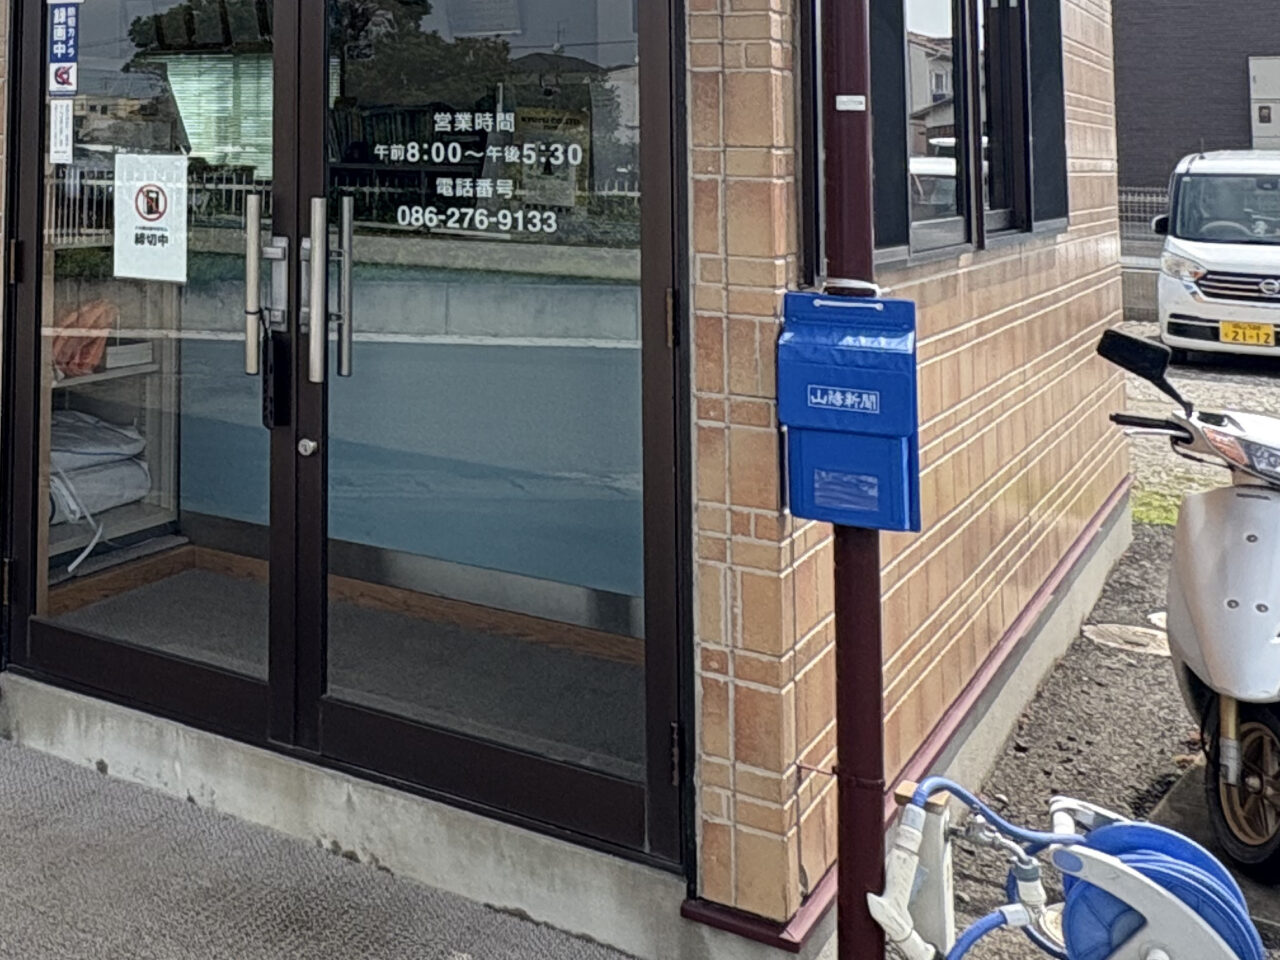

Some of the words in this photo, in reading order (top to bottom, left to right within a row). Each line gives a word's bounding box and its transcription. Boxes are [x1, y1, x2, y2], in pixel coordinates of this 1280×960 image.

[433, 112, 516, 133] 営業時間
[435, 177, 515, 199] 電話番号
[397, 205, 558, 233] 086-276-9133
